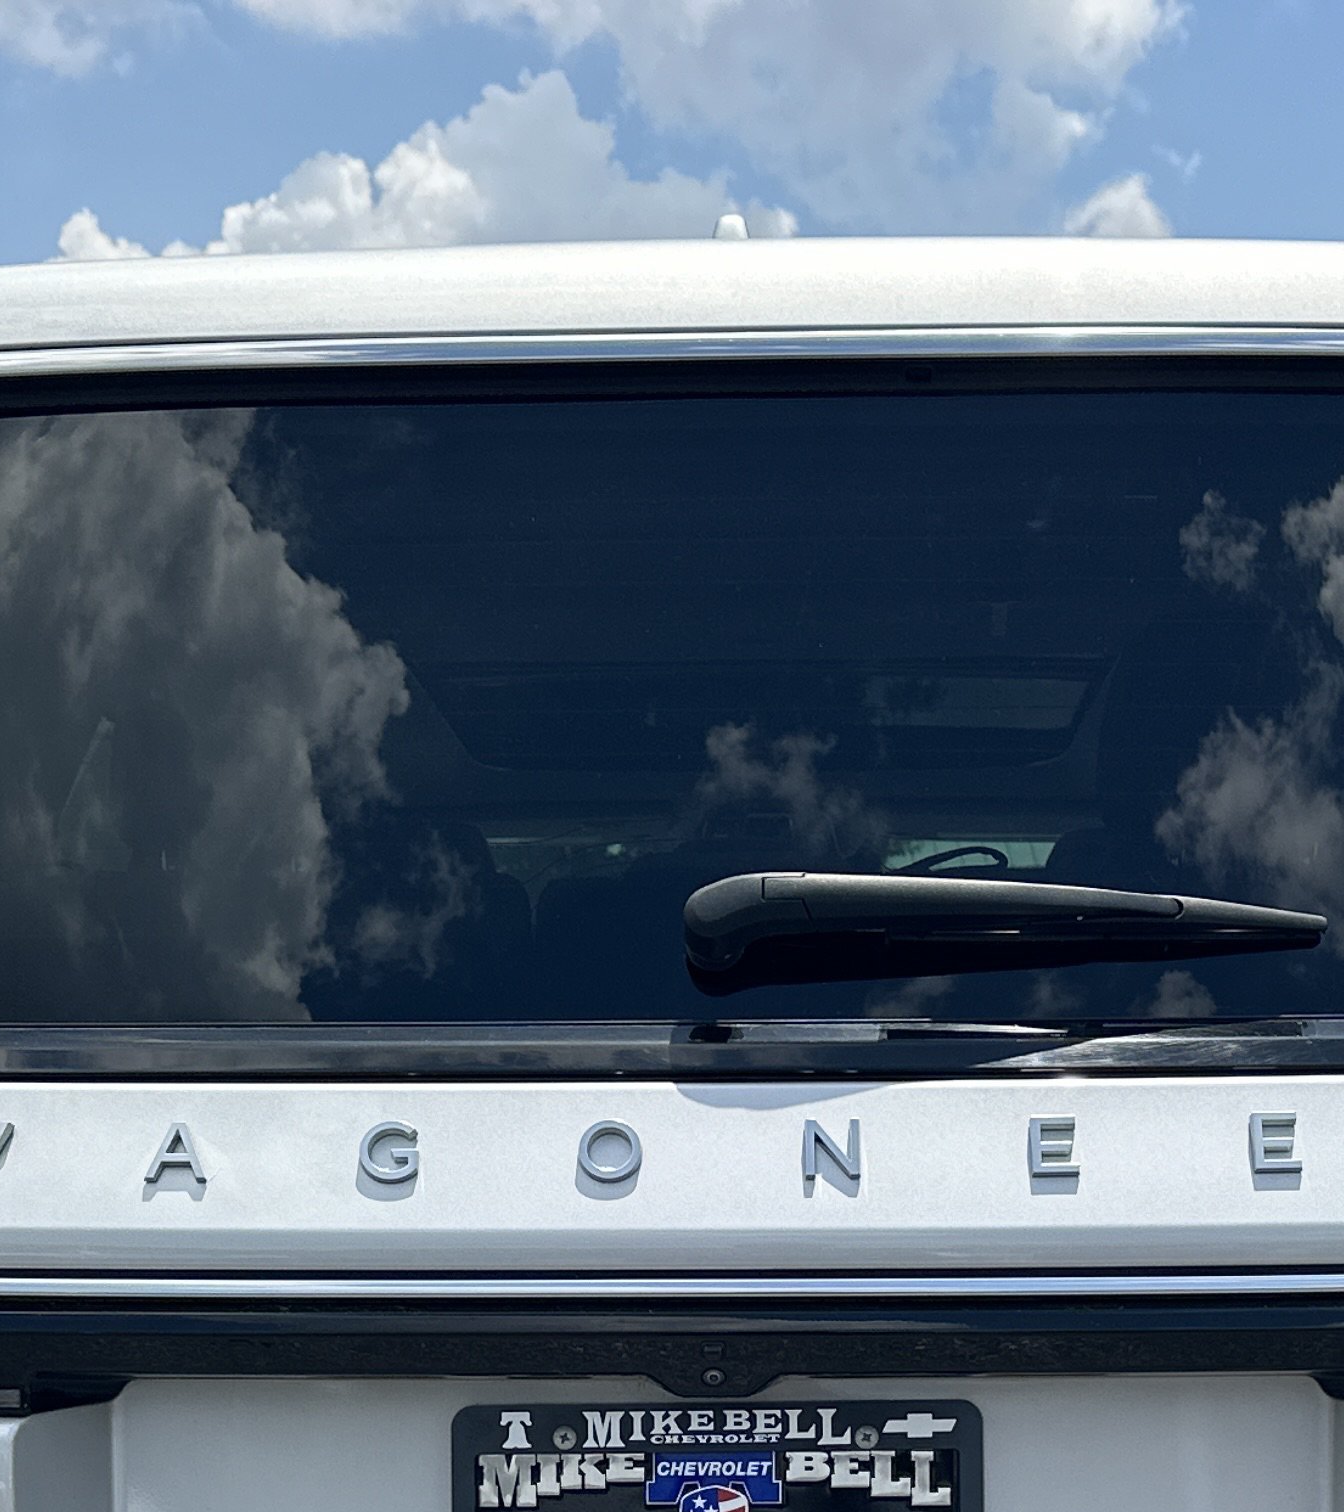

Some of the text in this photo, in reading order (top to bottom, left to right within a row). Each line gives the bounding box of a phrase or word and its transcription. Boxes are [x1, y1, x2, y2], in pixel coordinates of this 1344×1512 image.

[582, 1408, 852, 1449] MIKE BELL
[650, 1433, 780, 1445] CHEVROLET
[478, 1451, 952, 1508] MIKE BELL
[657, 1461, 773, 1477] CHEVROLET
